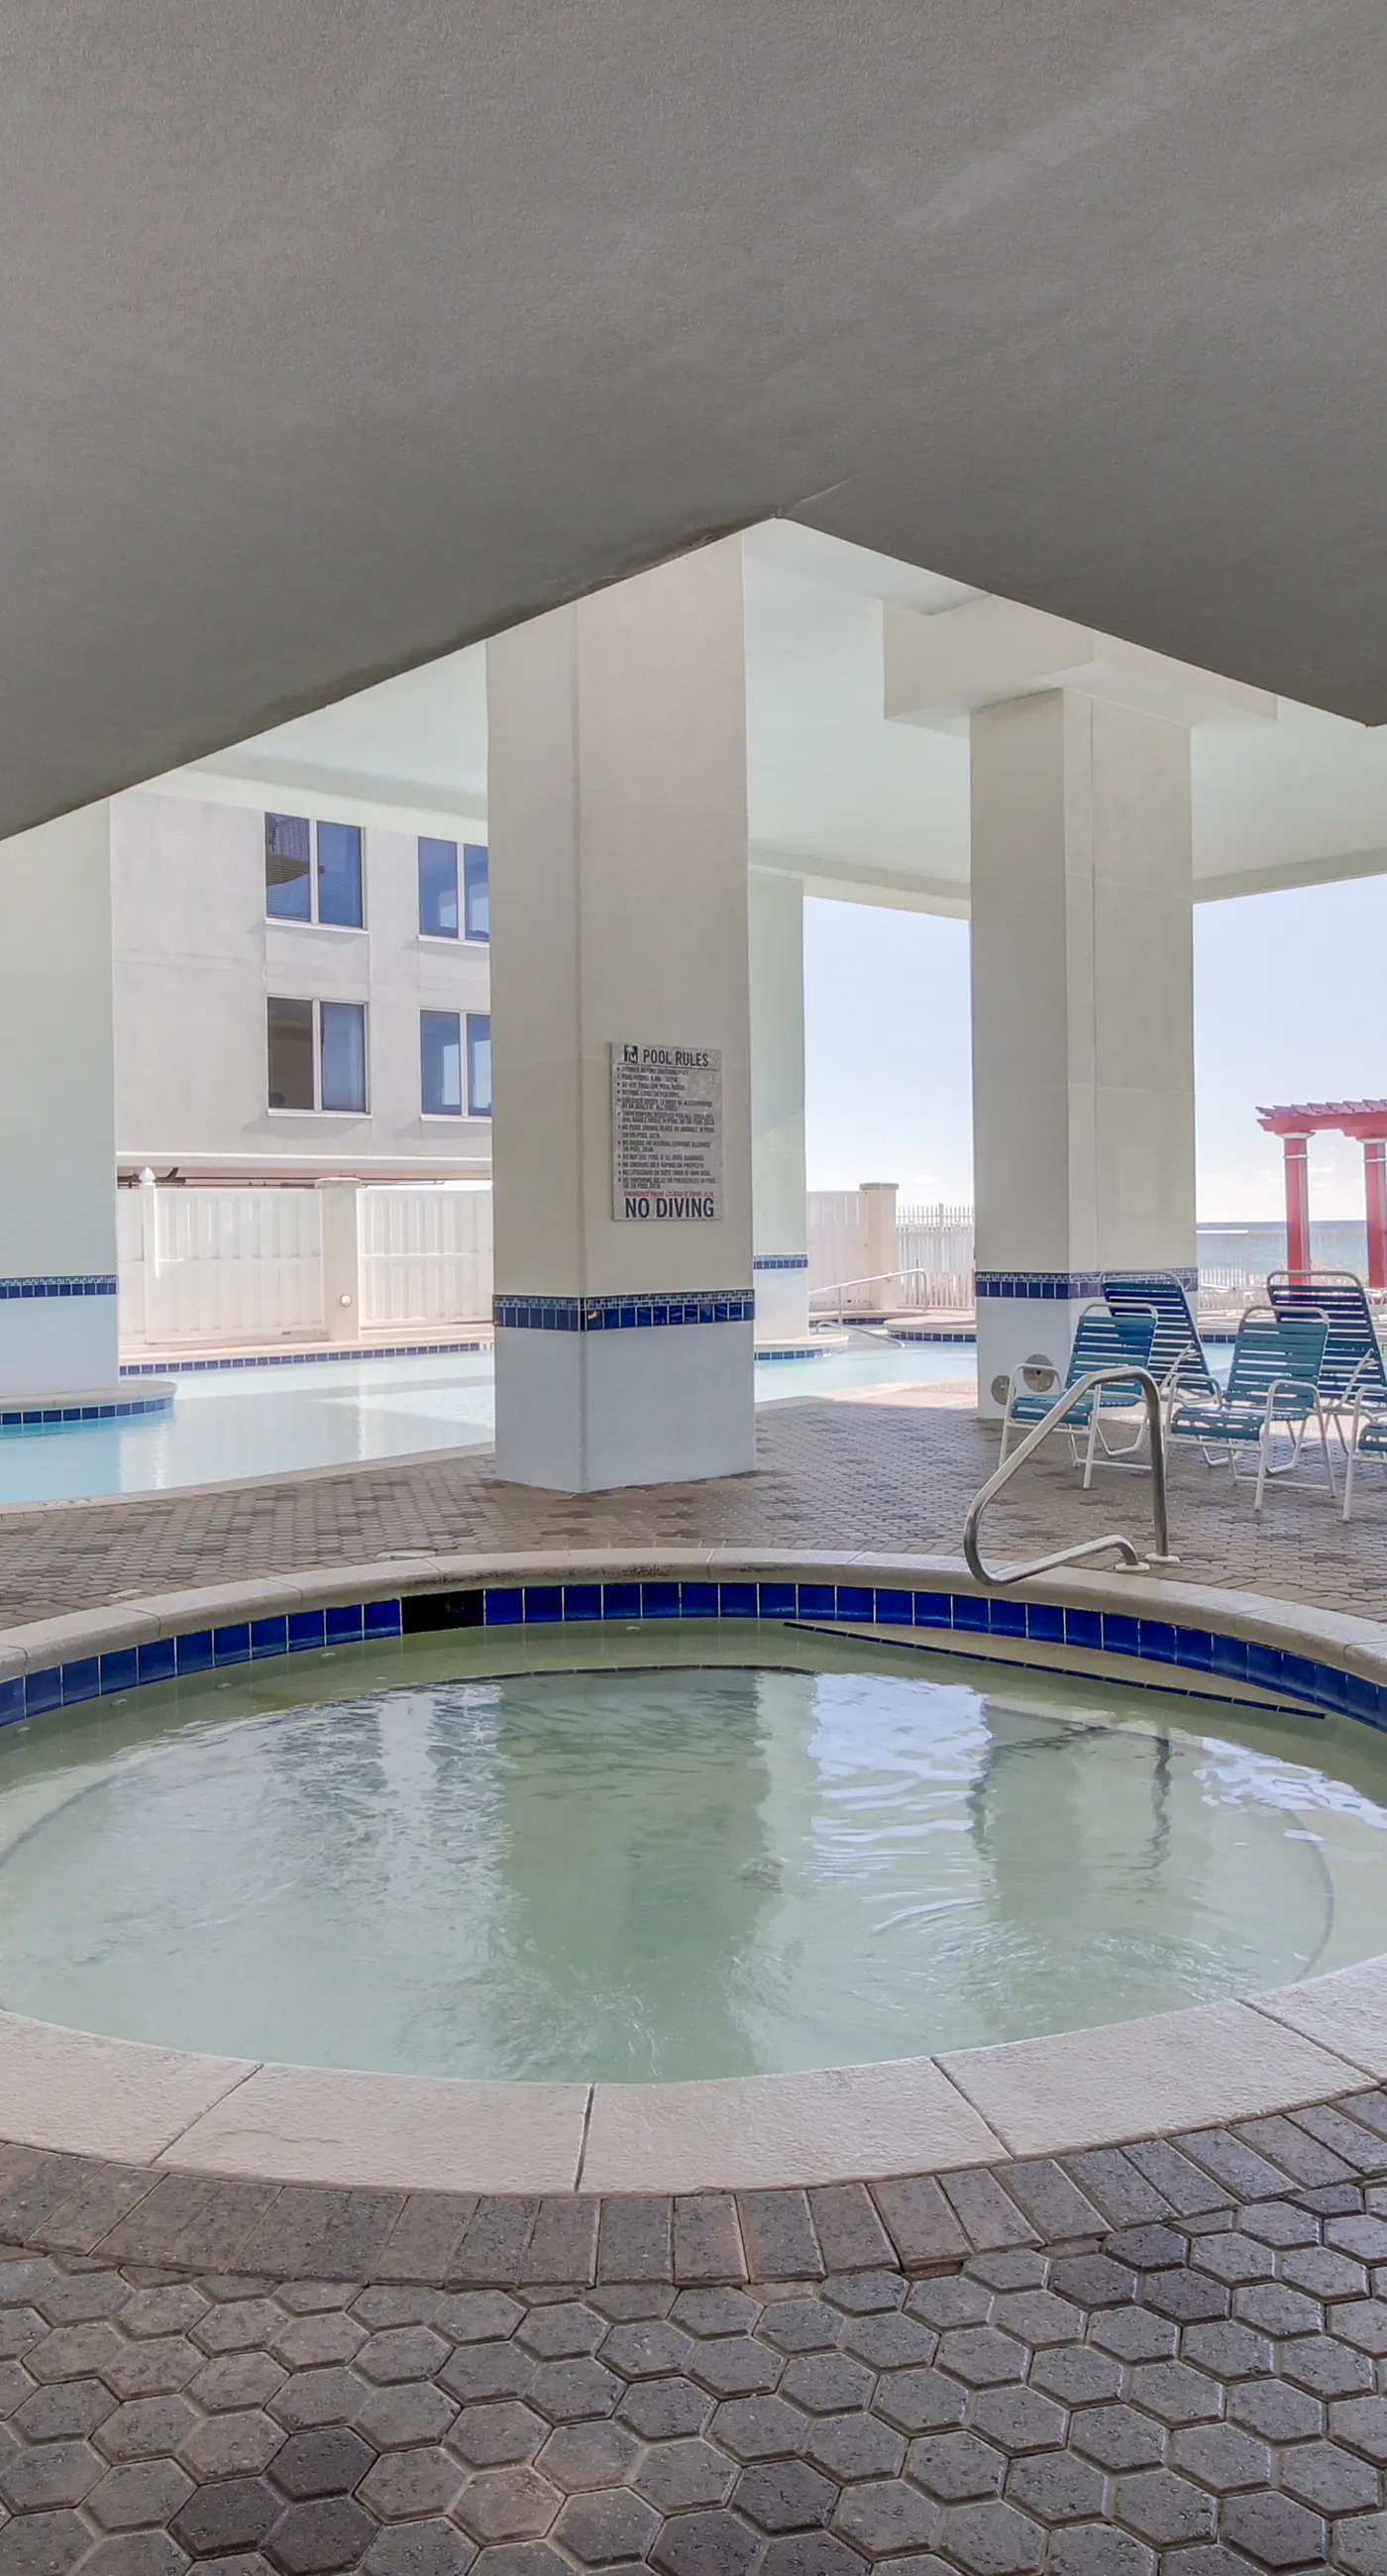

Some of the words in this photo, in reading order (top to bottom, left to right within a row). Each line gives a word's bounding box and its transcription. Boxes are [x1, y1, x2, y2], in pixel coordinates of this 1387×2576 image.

[643, 1049, 672, 1065] POOL
[676, 1051, 709, 1067] RULES
[625, 1198, 650, 1218] NO
[656, 1198, 714, 1218] DIVING
